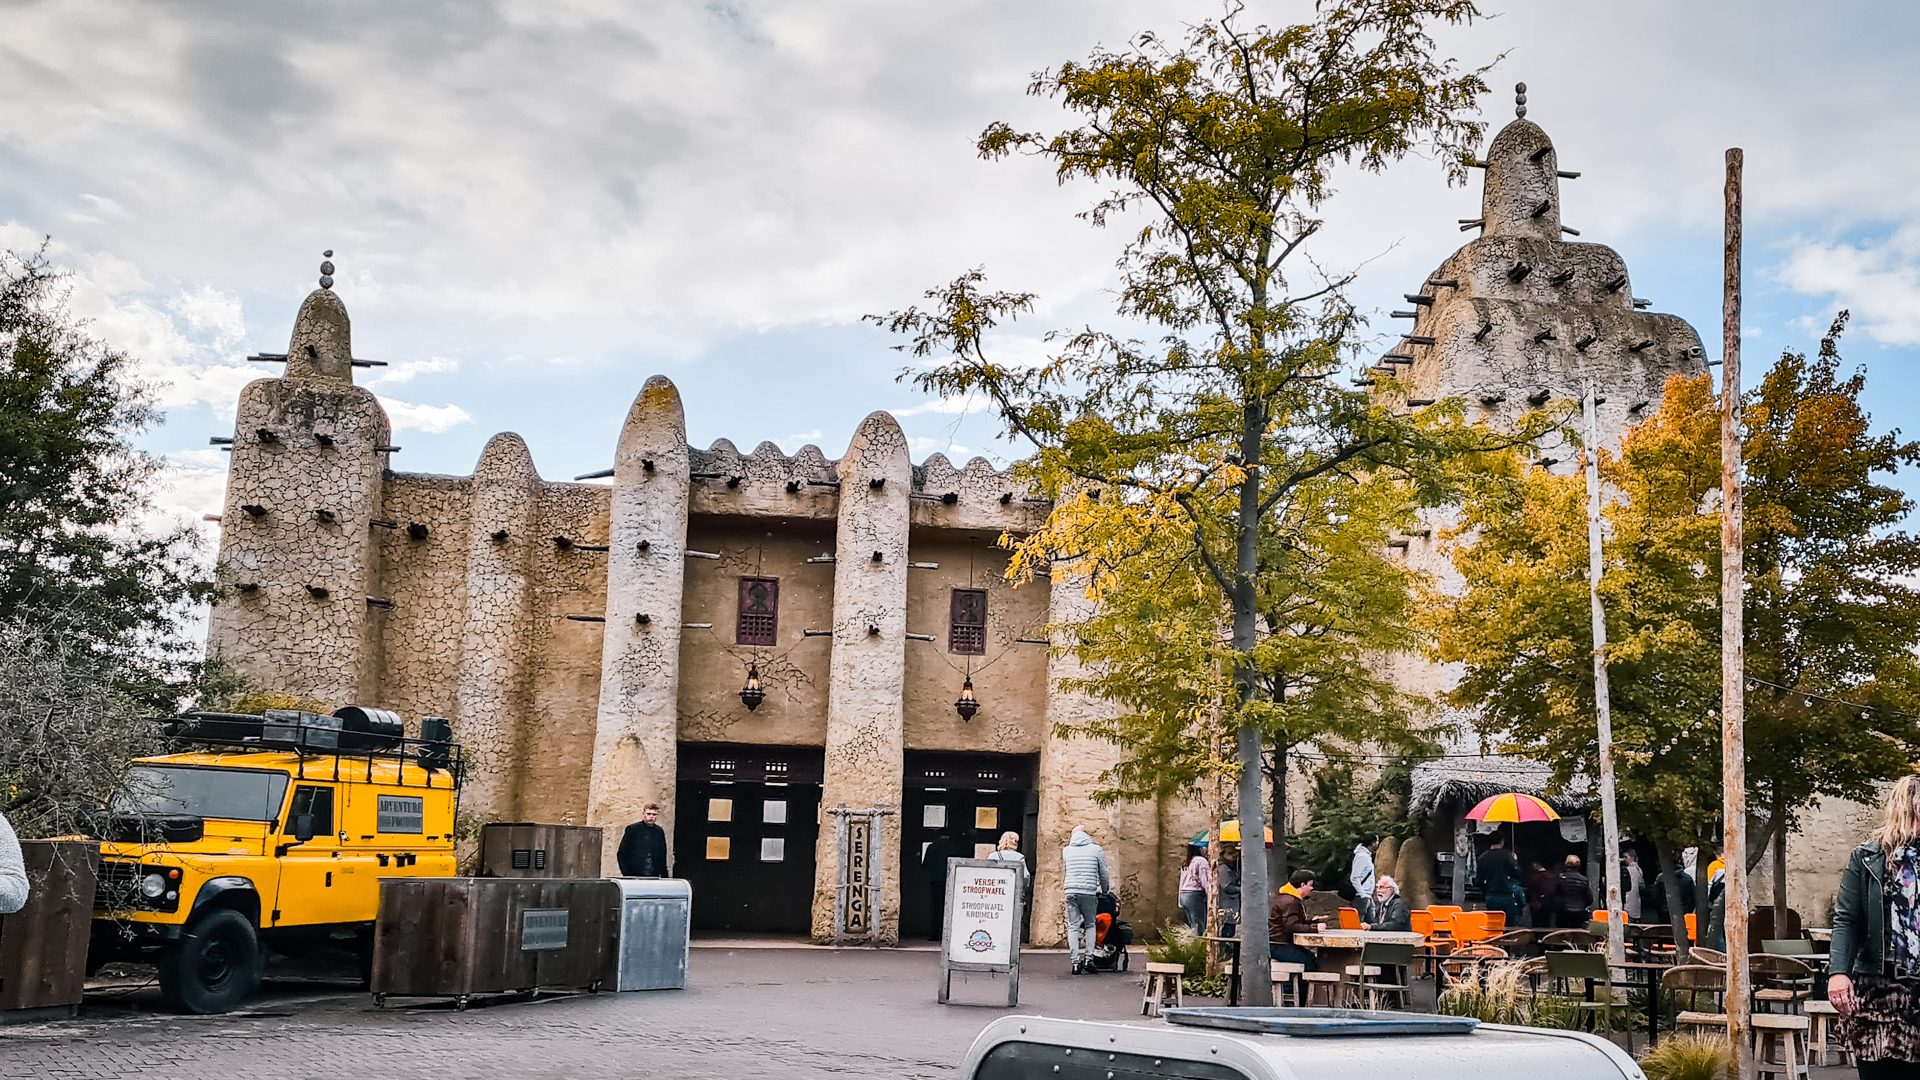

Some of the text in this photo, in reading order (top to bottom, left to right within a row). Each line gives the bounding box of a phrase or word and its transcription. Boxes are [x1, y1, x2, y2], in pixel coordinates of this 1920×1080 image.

[378, 800, 422, 813] ADVENTURE
[850, 826, 863, 928] SERENGA
[974, 878, 995, 886] VERSE
[962, 886, 1006, 895] STROOPWAFEL
[961, 901, 1005, 911] STROOPWAFEL
[965, 911, 1000, 919] KRUIMELS
